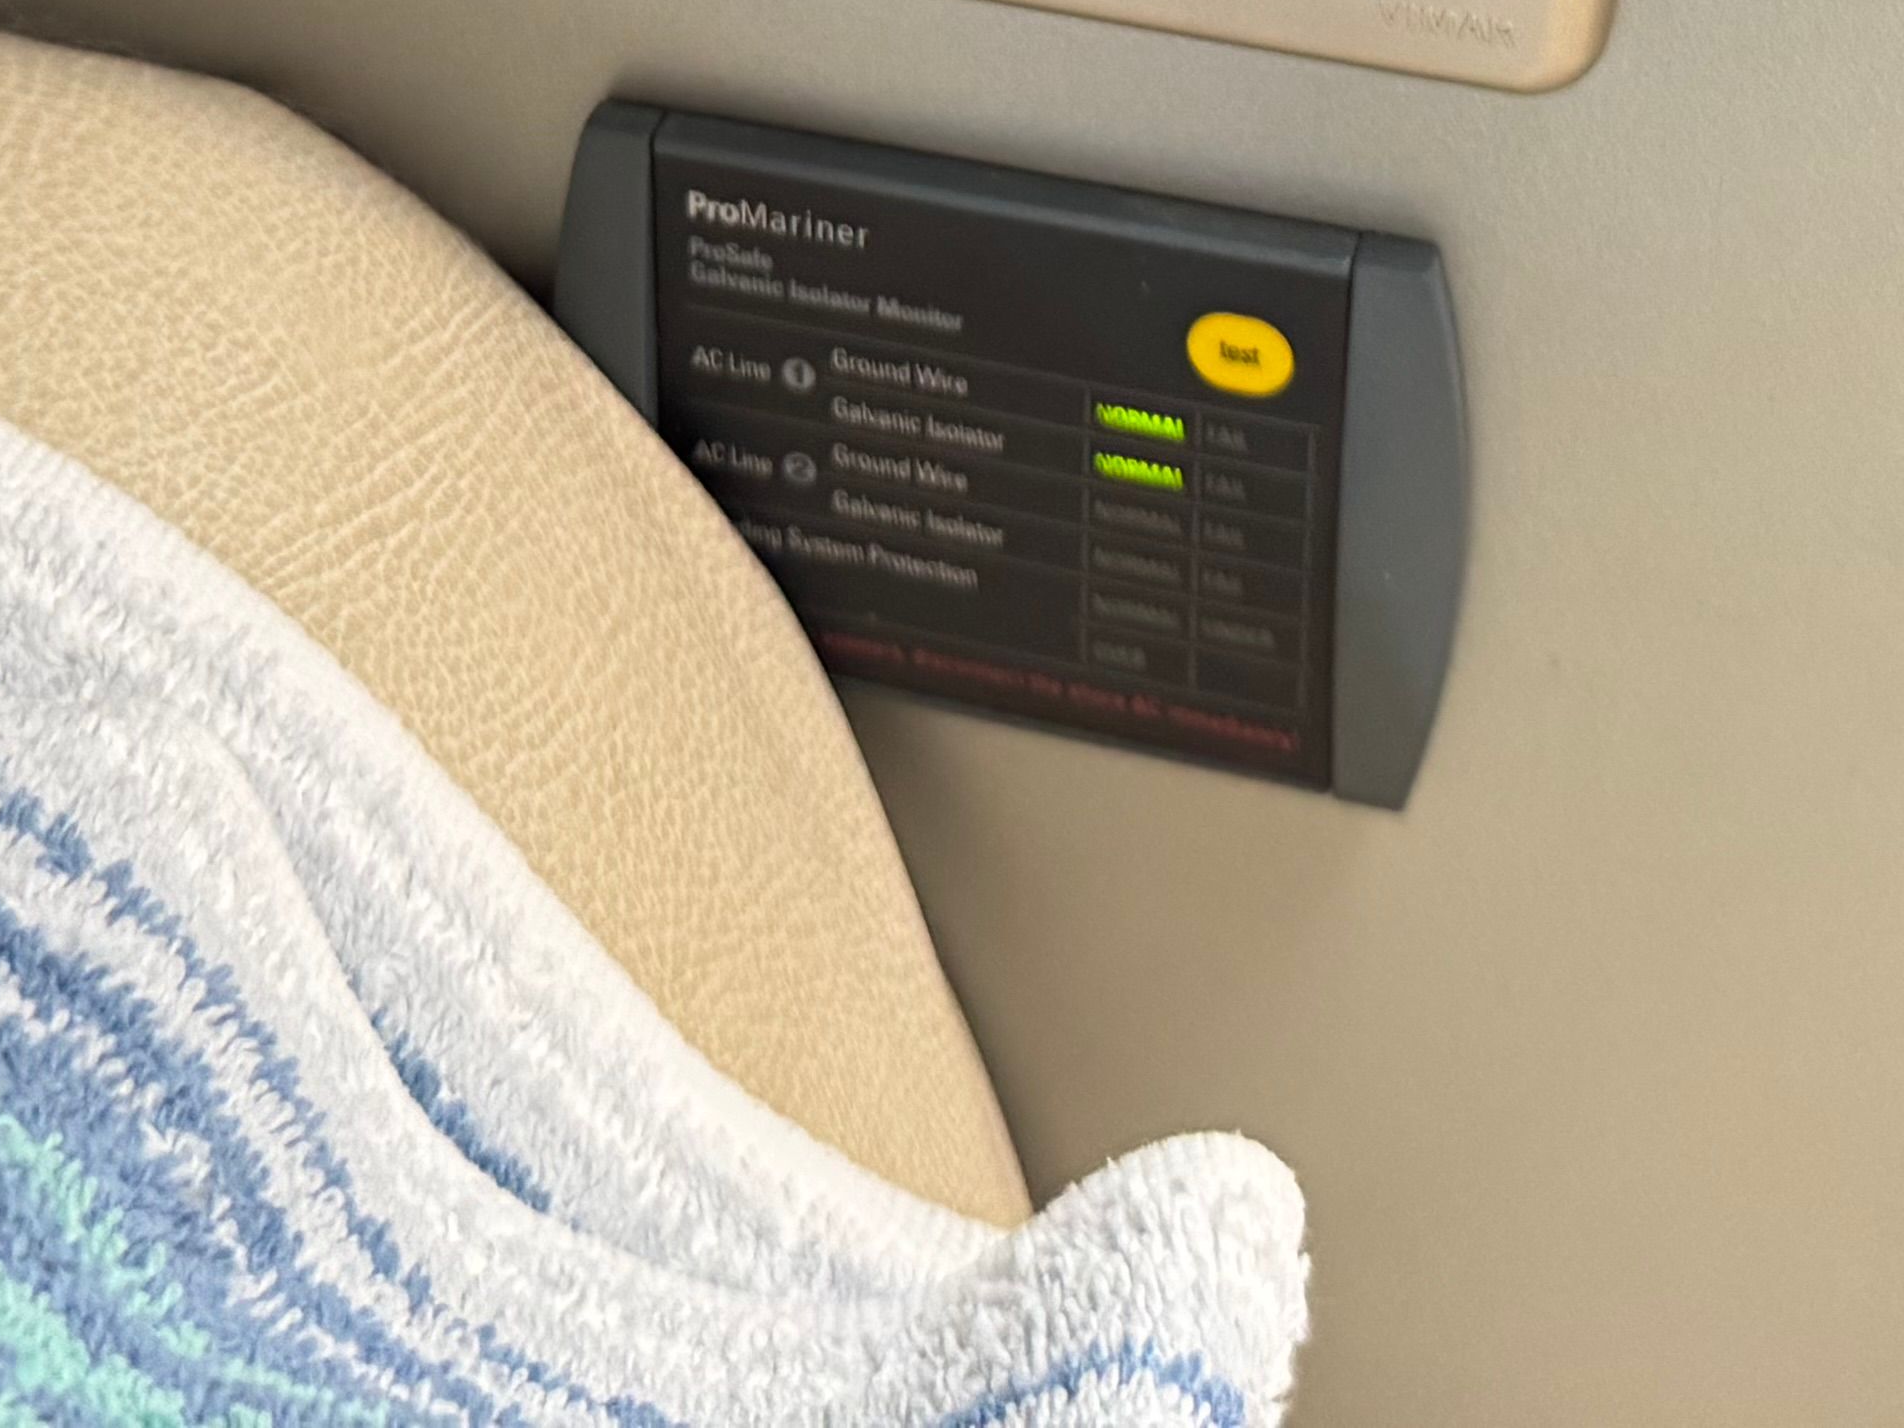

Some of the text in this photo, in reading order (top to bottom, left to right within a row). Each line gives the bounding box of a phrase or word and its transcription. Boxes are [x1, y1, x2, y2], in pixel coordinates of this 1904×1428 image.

[687, 188, 871, 250] ProMariner
[692, 344, 726, 370] AC
[728, 350, 772, 382] Line
[830, 346, 969, 396] Ground Wire
[1218, 339, 1262, 366] test
[831, 395, 1005, 452] Galvanic Isolator
[830, 442, 969, 492] Ground Wire
